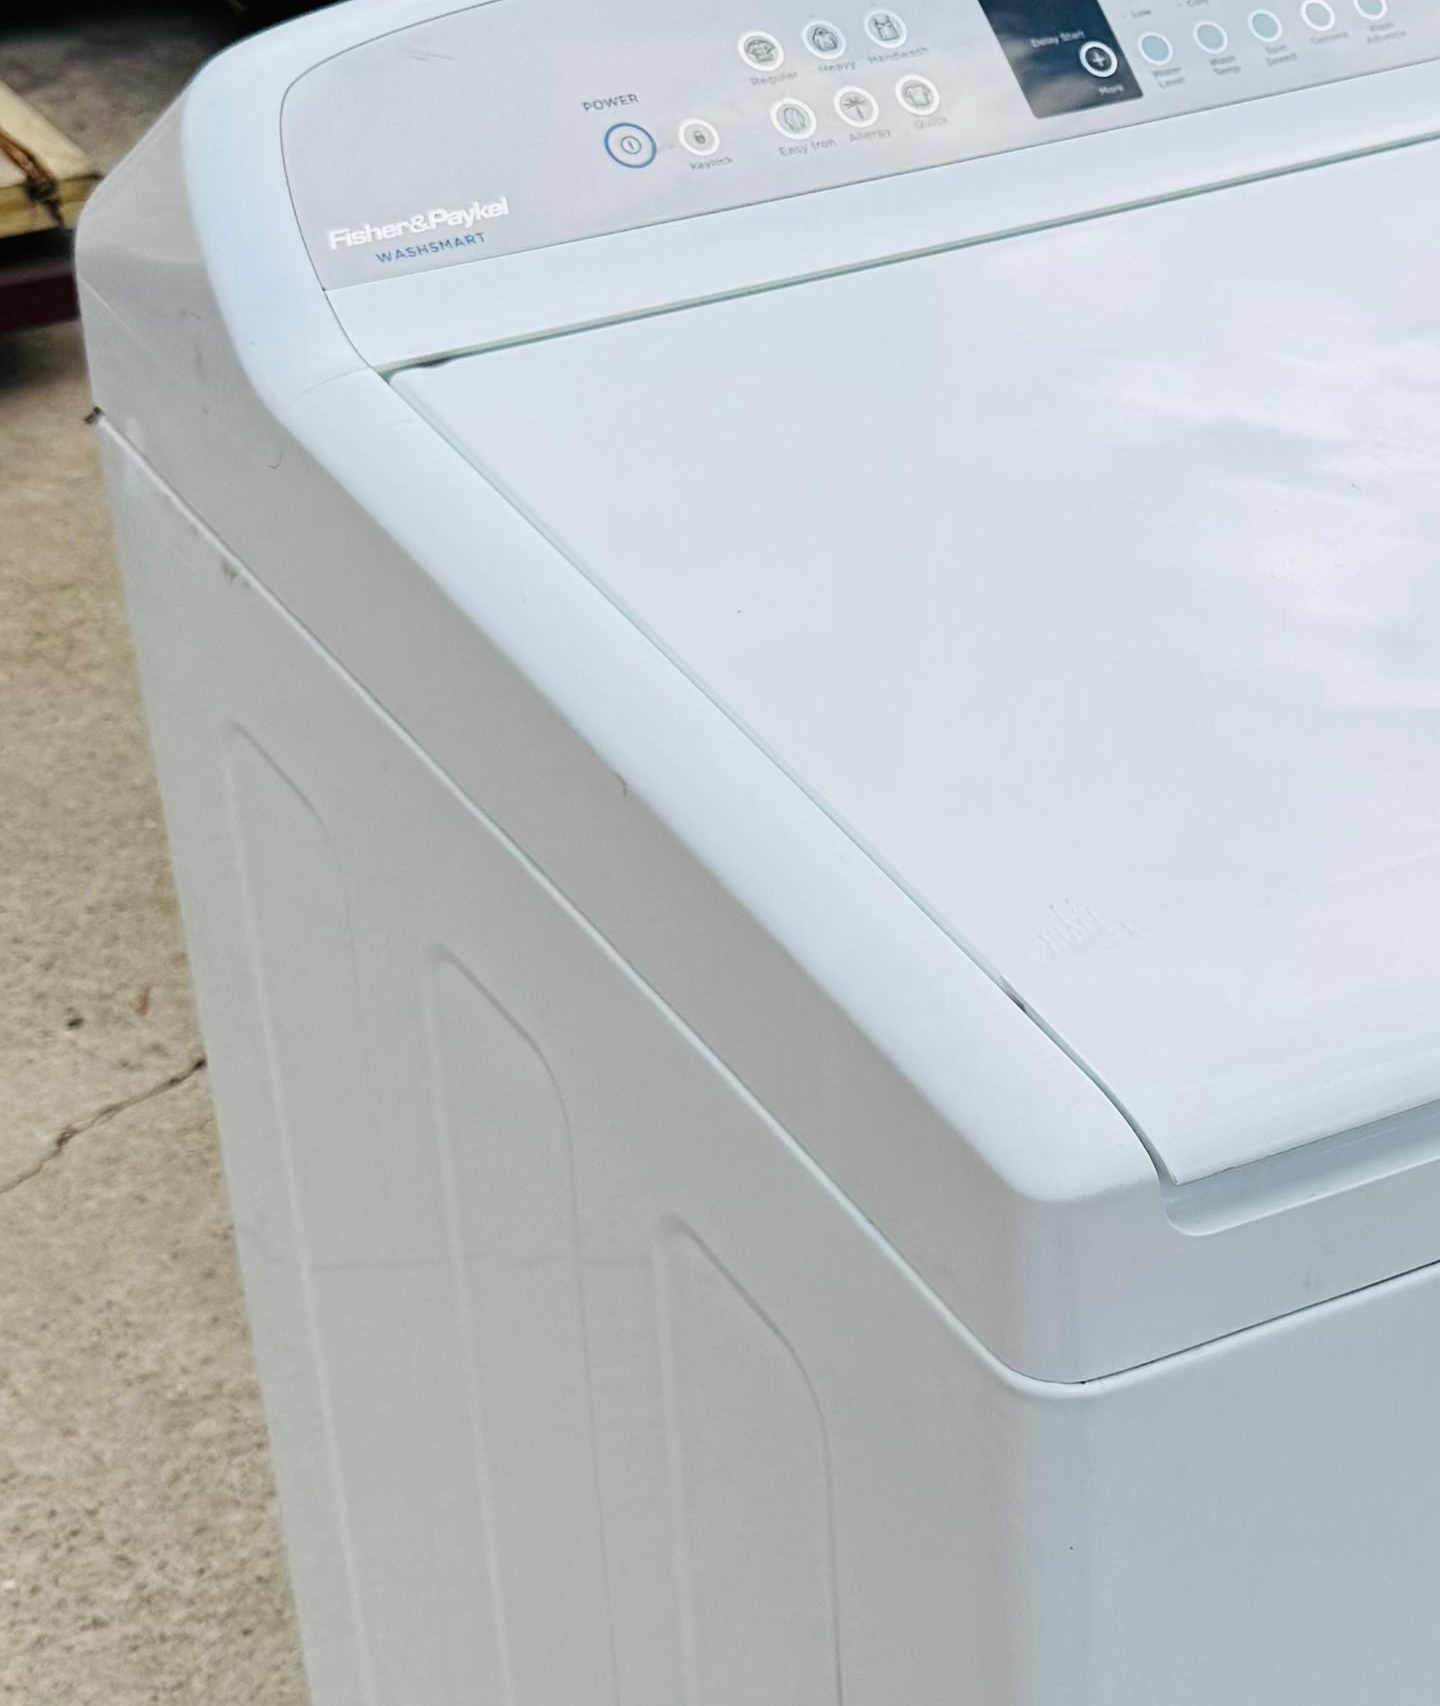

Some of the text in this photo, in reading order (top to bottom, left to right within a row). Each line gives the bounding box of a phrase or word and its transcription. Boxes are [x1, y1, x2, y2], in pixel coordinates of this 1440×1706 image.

[1030, 30, 1085, 48] Delay Start
[750, 70, 798, 86] Regular
[582, 93, 639, 112] POWER
[779, 137, 837, 157] Easy Iron
[328, 196, 509, 250] Fisher&Paykel
[376, 232, 486, 264] WASHSMART
